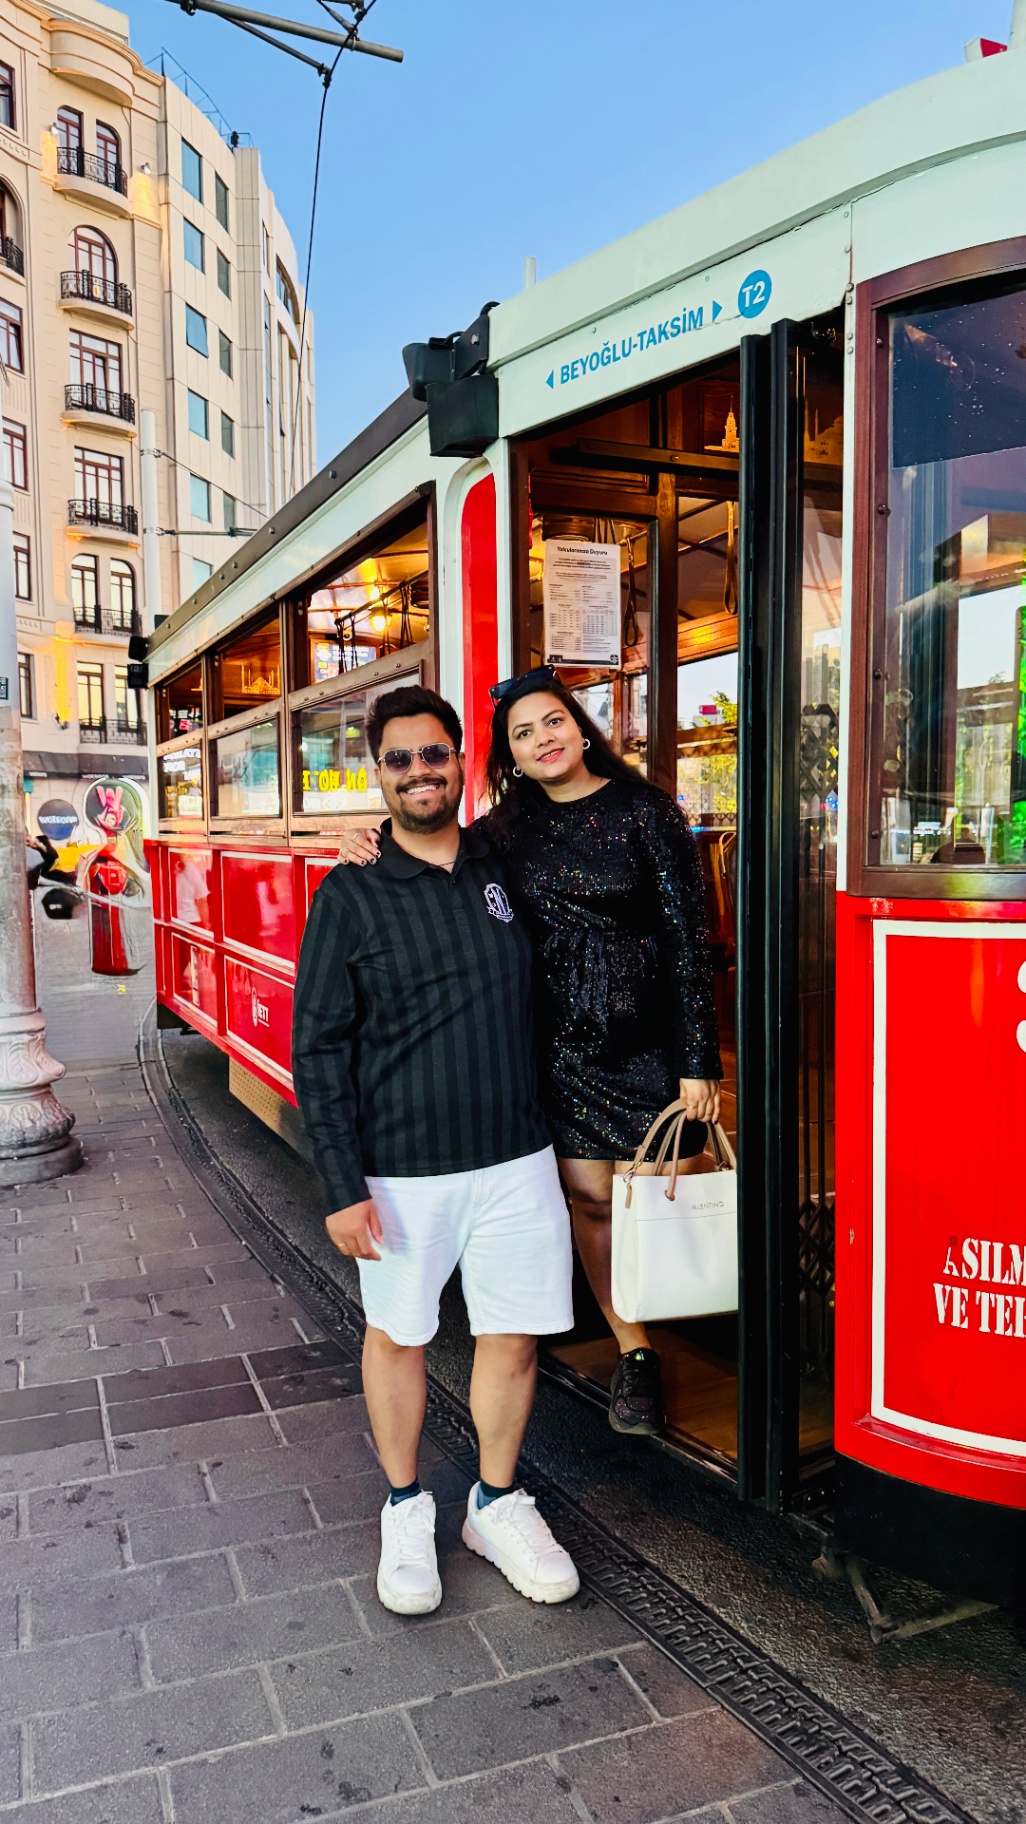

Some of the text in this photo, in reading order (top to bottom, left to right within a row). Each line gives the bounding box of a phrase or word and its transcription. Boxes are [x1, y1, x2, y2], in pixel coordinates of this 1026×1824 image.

[560, 281, 766, 385] BEYOĞLU-TAKSİM T2
[933, 1282, 969, 1329] VE
